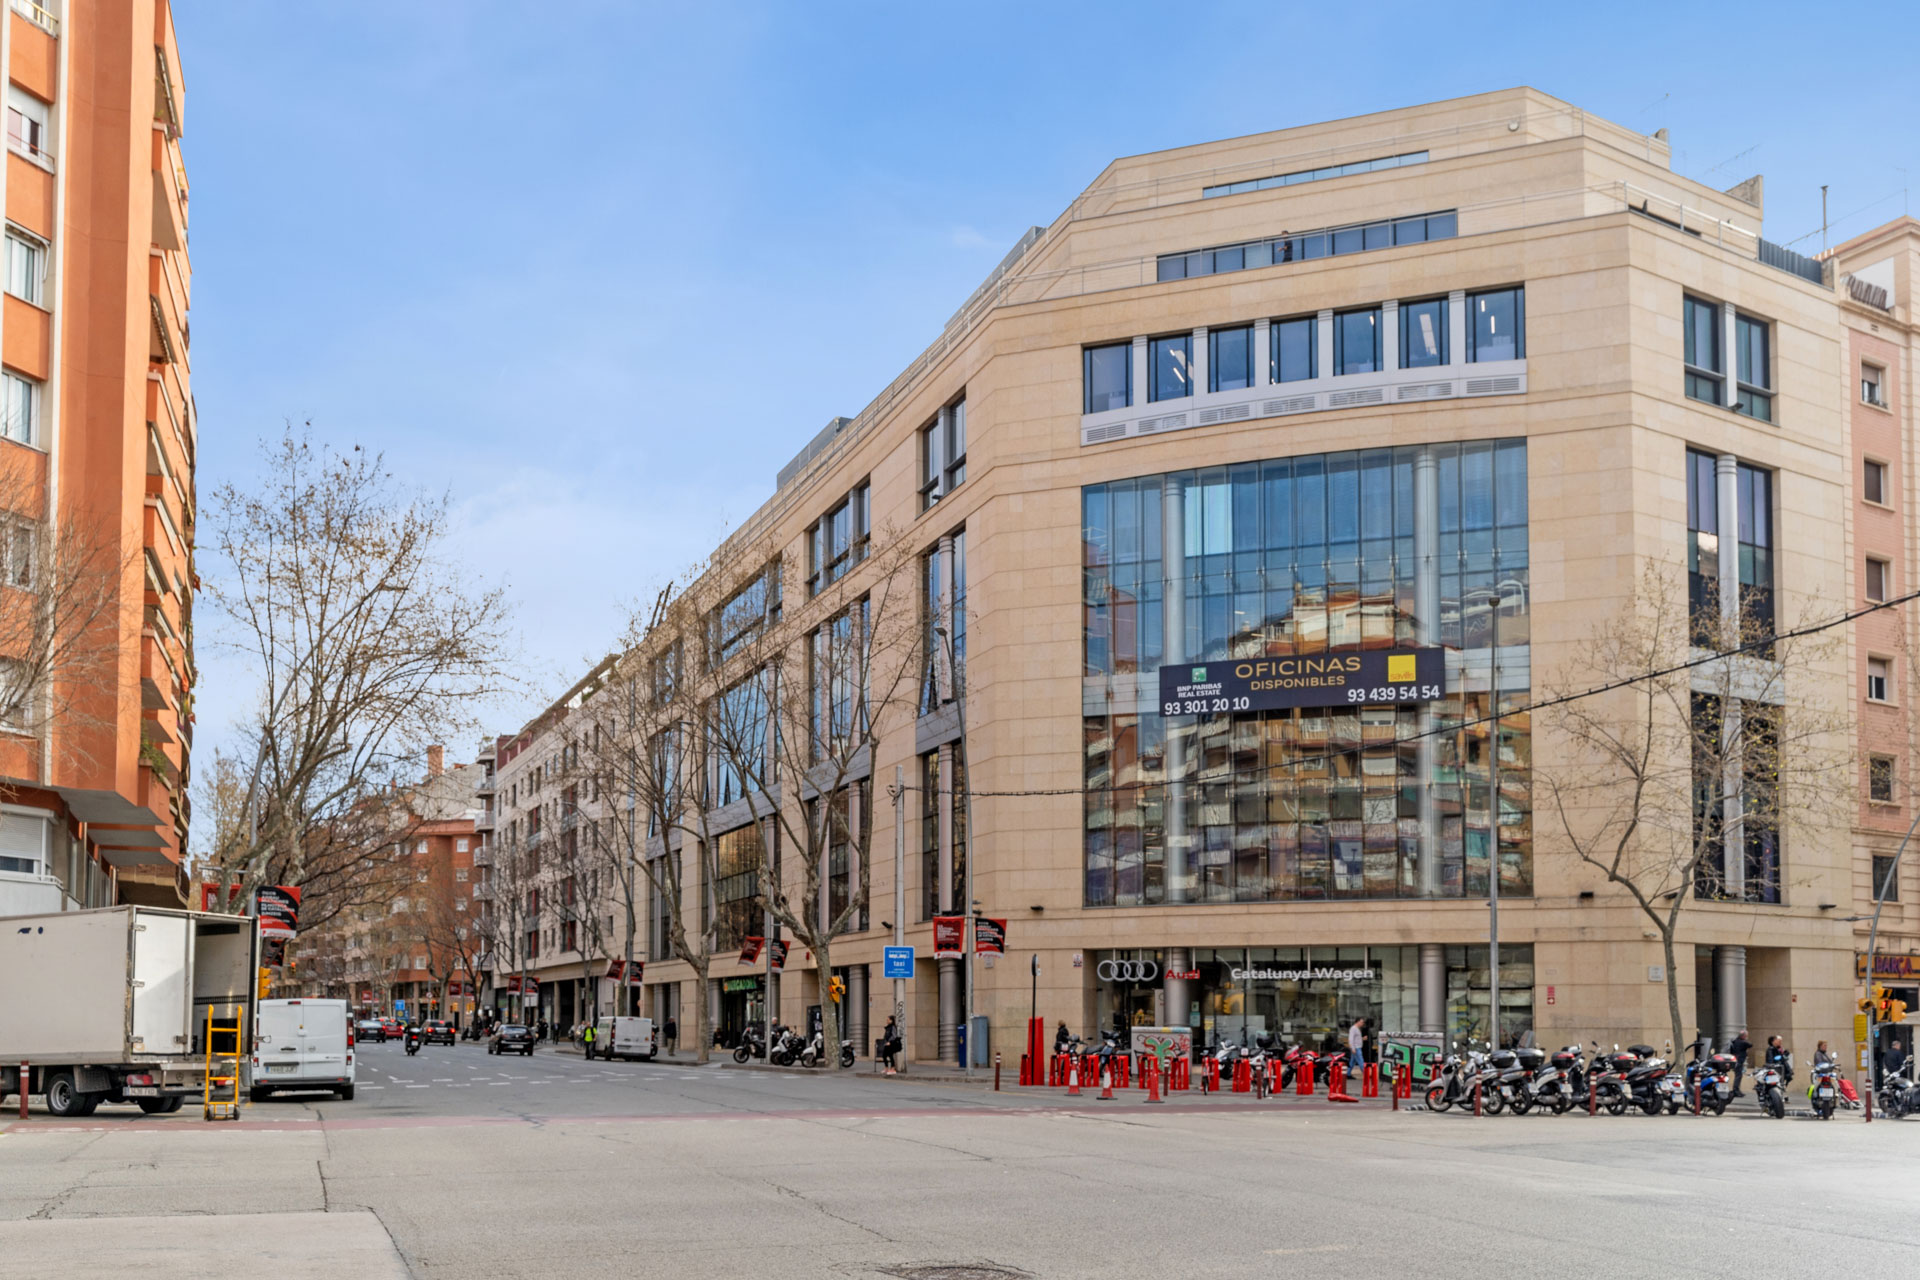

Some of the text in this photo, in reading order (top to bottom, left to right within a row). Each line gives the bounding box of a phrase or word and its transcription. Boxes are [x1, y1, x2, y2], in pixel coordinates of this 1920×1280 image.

[1235, 656, 1361, 679] OFICINAS
[1192, 682, 1222, 691] PARIBAS
[1250, 675, 1346, 691] DISPONIBLES
[1196, 689, 1221, 697] ESTATE
[1347, 685, 1440, 702] 93 439 54 54
[1164, 696, 1250, 715] 93 301 20 10
[1164, 968, 1201, 980] Audi
[1231, 966, 1374, 982] Catalunya Wagen
[1874, 956, 1913, 977] BARÇA
